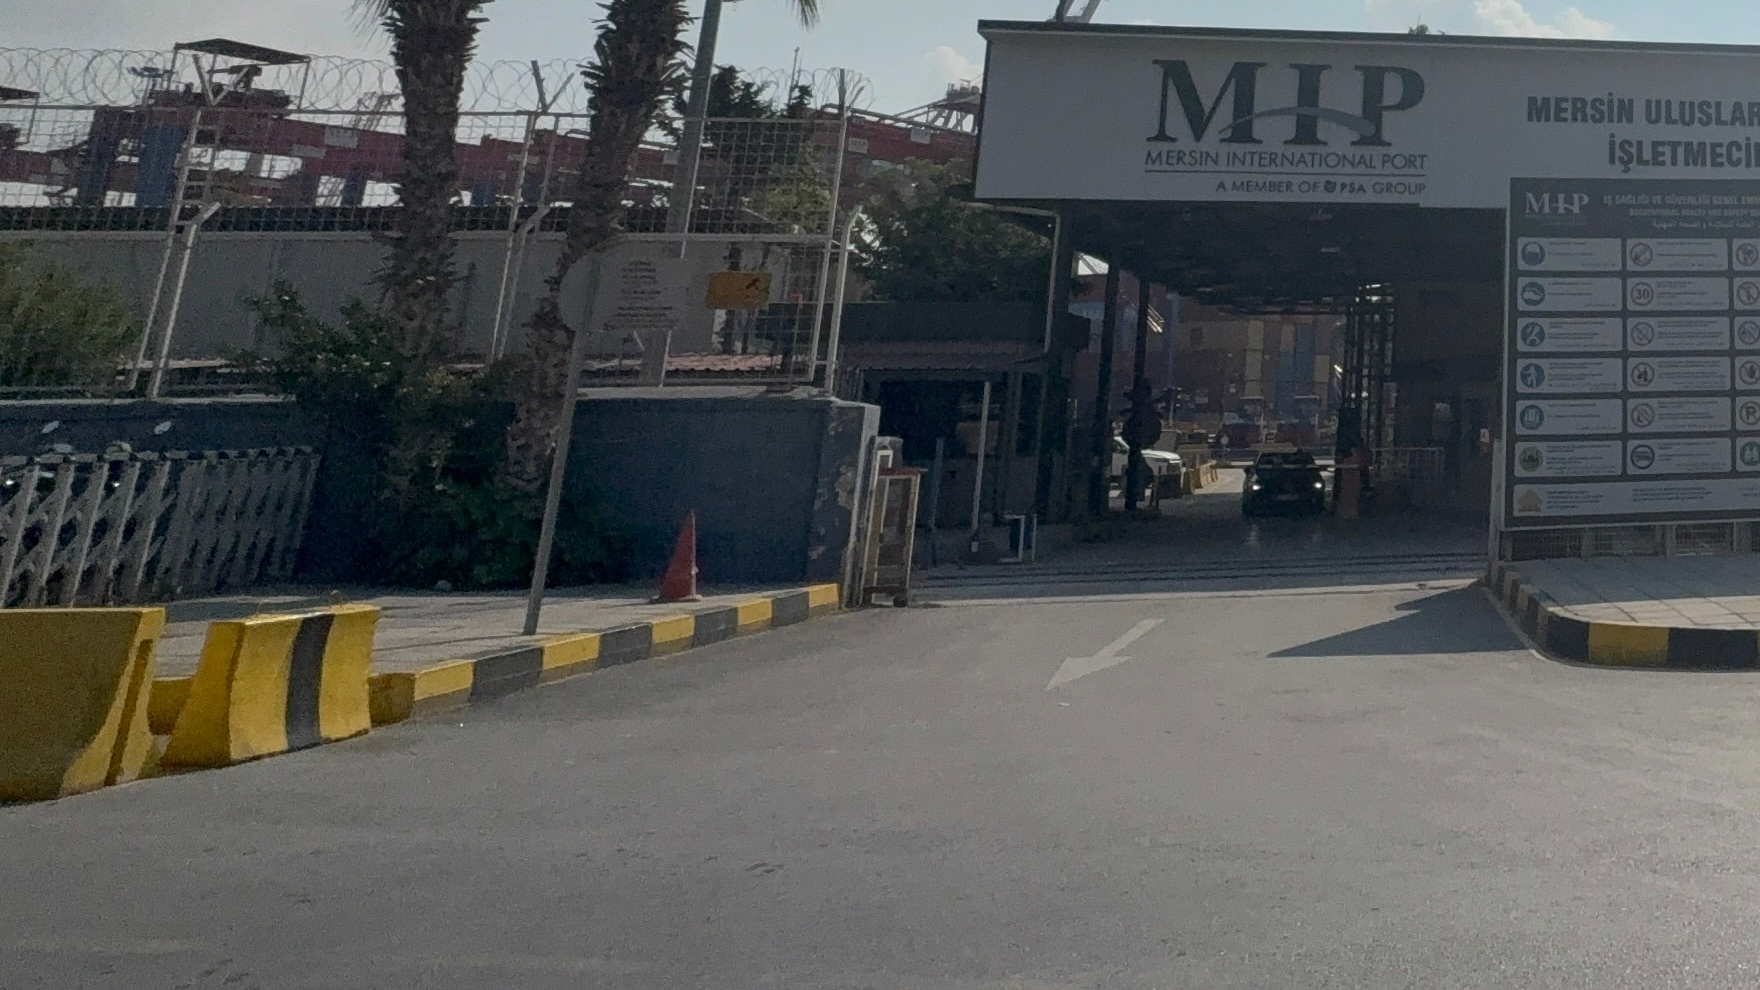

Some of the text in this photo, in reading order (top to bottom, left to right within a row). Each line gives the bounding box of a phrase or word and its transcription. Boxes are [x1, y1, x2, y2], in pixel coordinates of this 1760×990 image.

[1146, 58, 1426, 147] MIP
[1527, 92, 1635, 124] MERSİN
[1226, 150, 1376, 170] INTERNATIONAL
[1381, 153, 1428, 171] PORT
[1216, 180, 1427, 195] A MEMBER OF PSA GROUP
[1525, 192, 1590, 214] MIP
